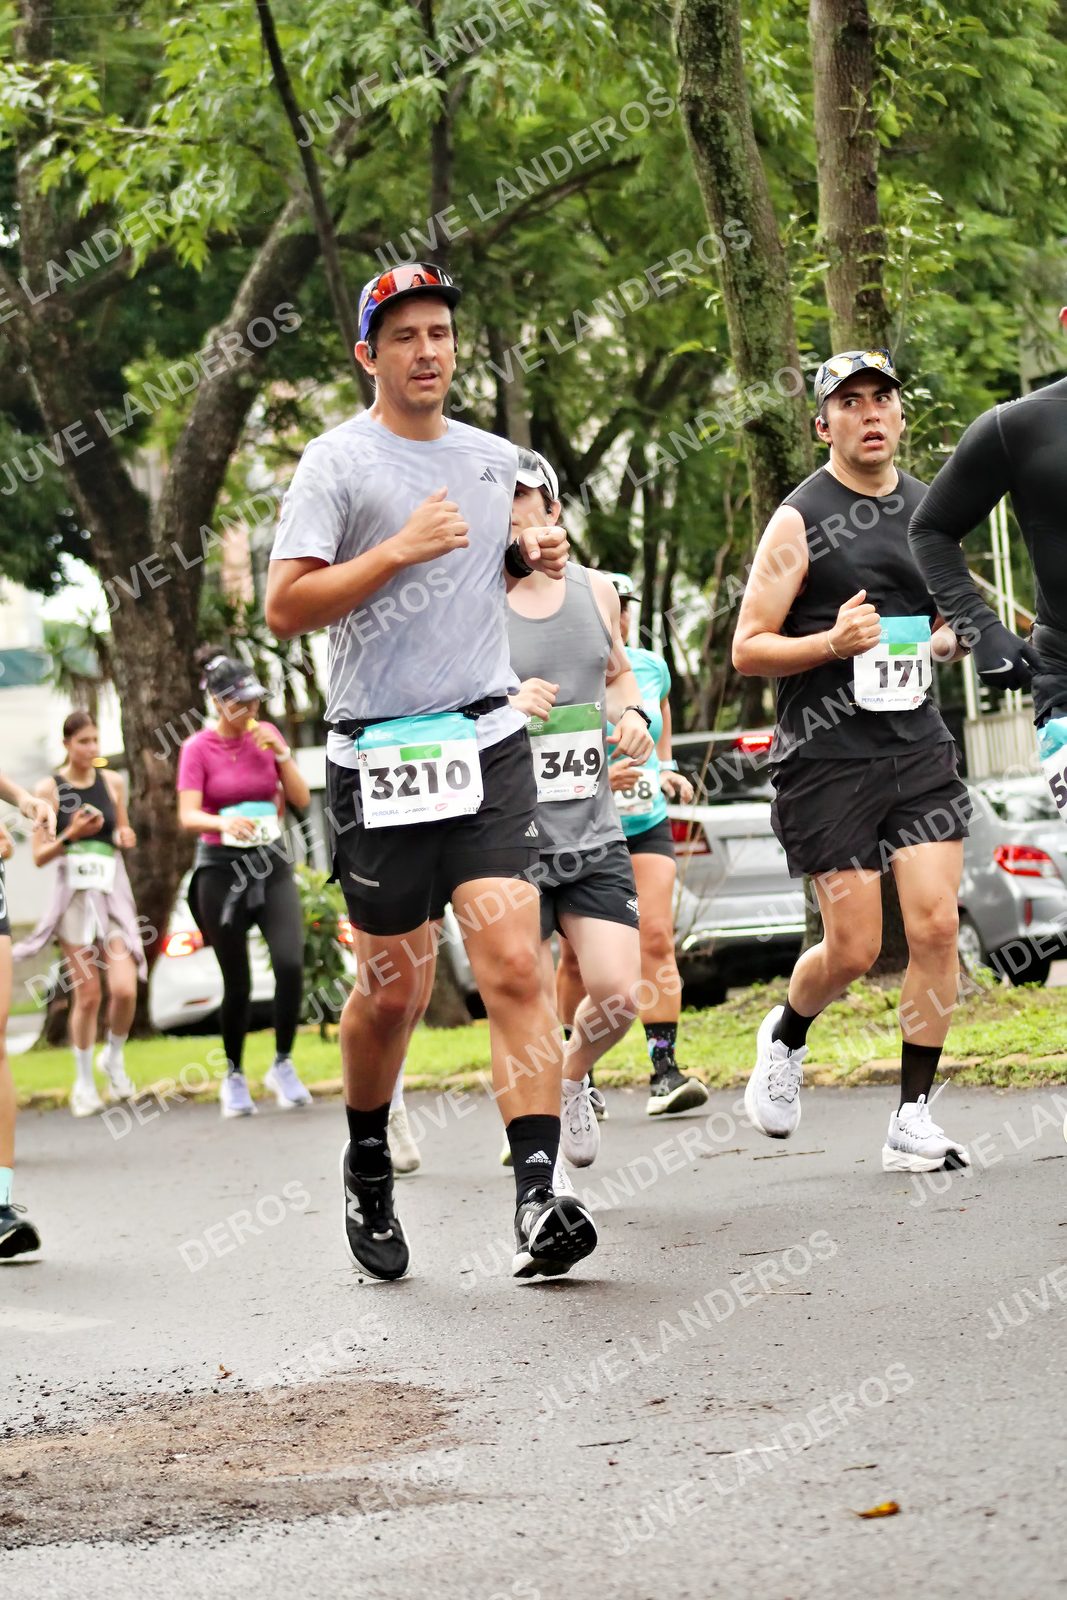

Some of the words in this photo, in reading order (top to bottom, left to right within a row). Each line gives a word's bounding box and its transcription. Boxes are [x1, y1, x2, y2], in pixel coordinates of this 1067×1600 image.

[874, 659, 923, 689] 171
[540, 747, 601, 780] 349
[368, 759, 472, 801] 3210
[525, 1157, 553, 1166] adidas
